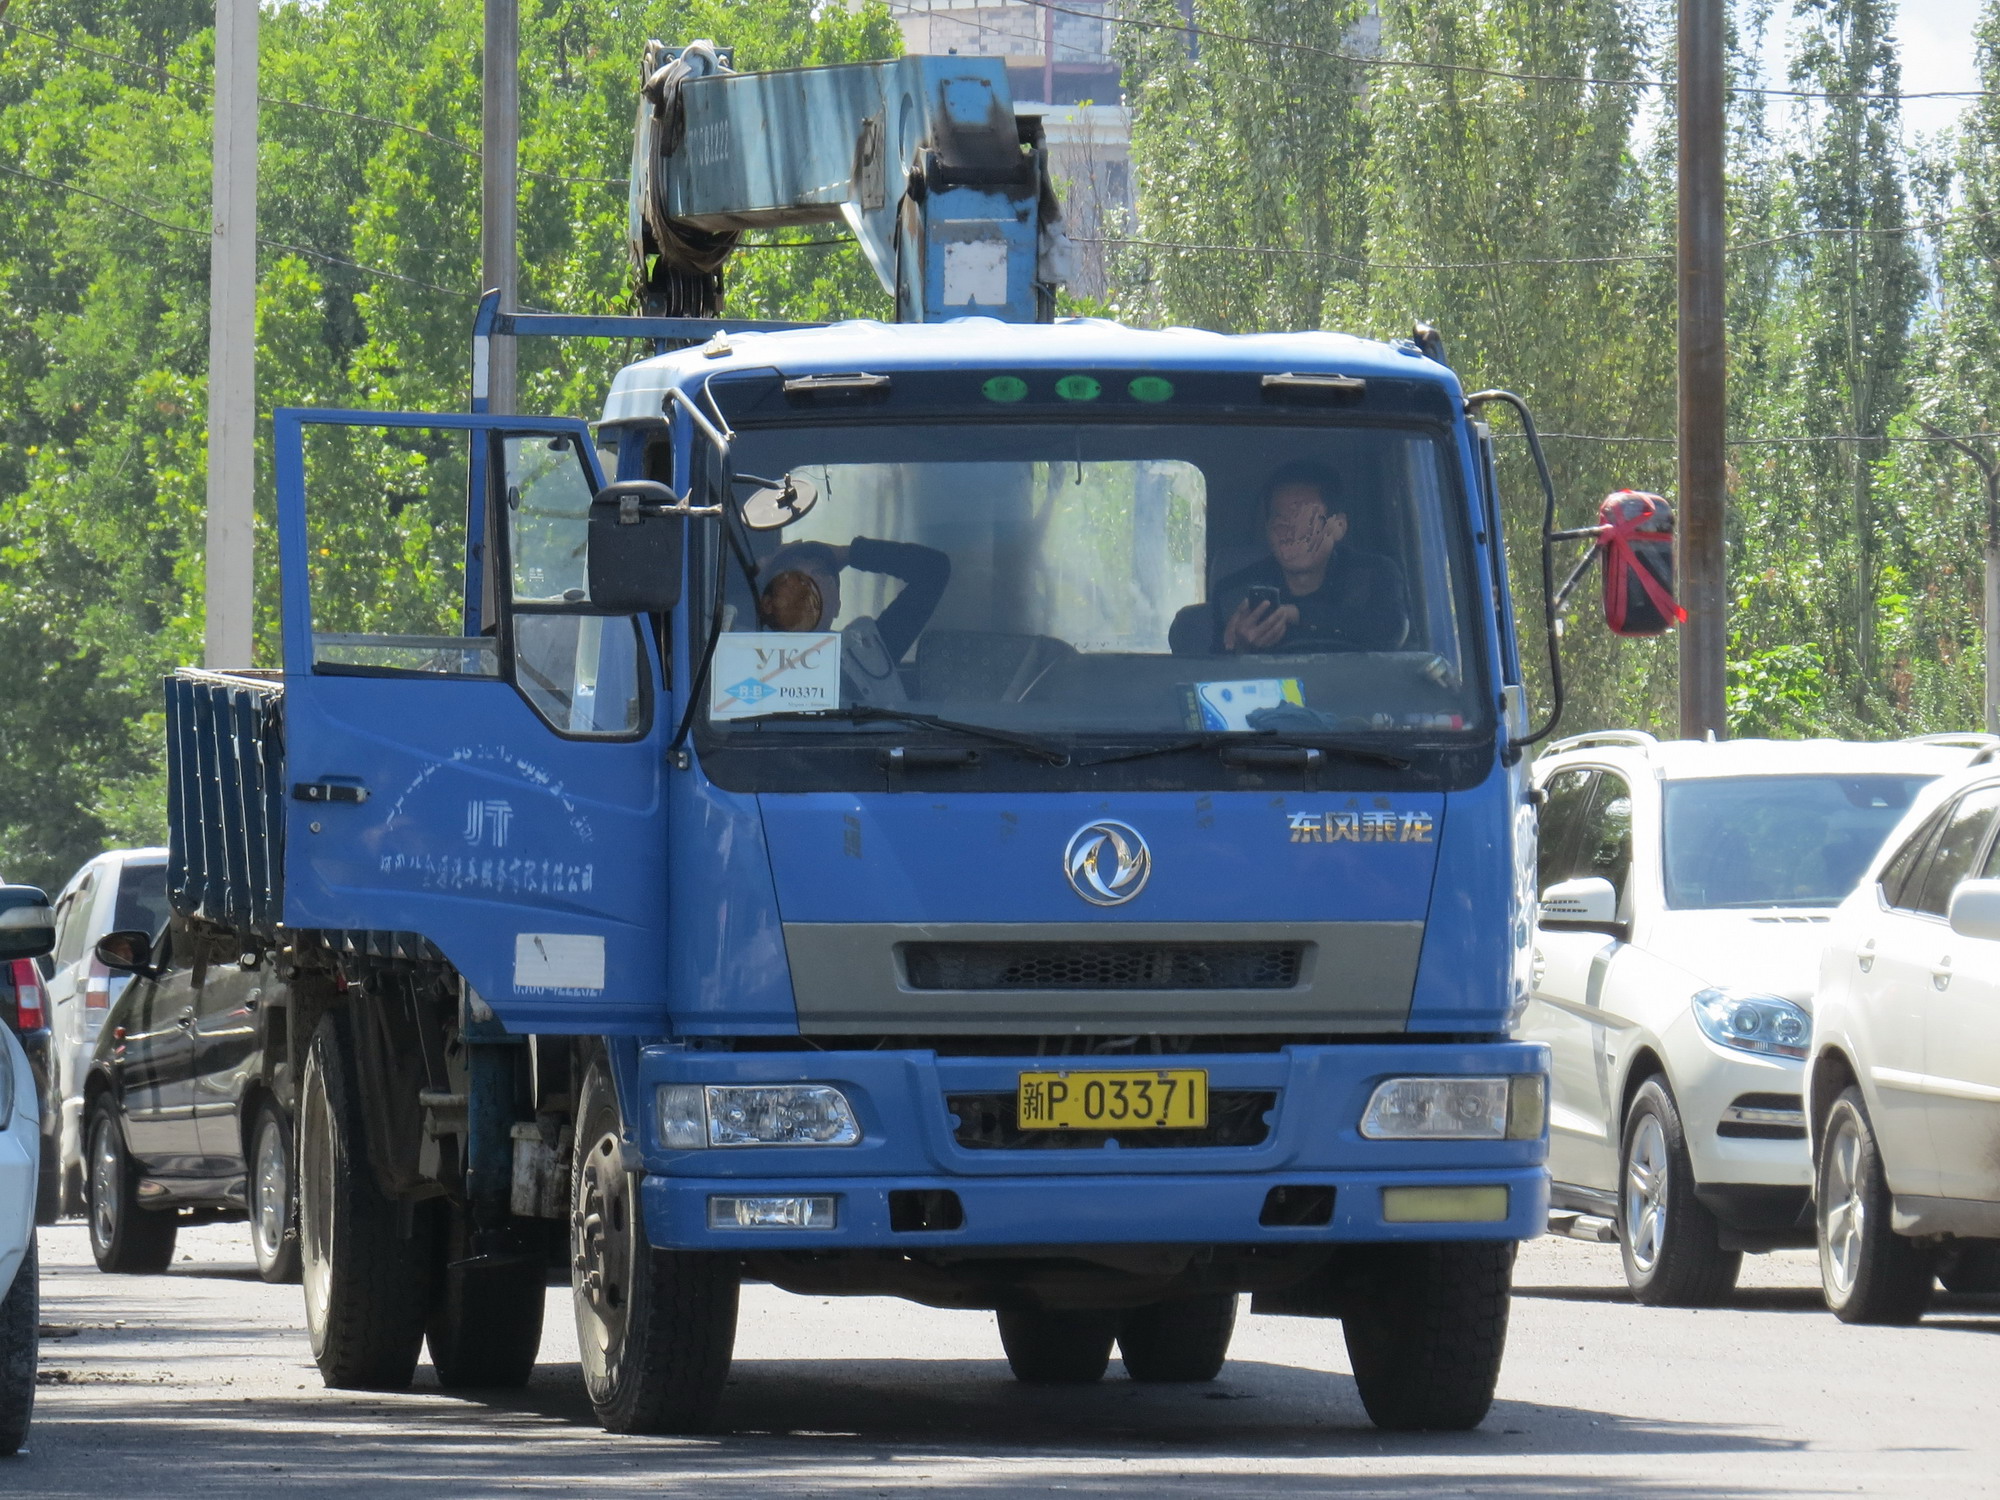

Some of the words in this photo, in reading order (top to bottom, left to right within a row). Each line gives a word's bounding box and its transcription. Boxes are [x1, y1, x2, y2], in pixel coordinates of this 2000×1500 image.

[754, 647, 821, 670] УКС
[780, 686, 825, 698] P03371
[1286, 811, 1434, 843] 东风乘龙
